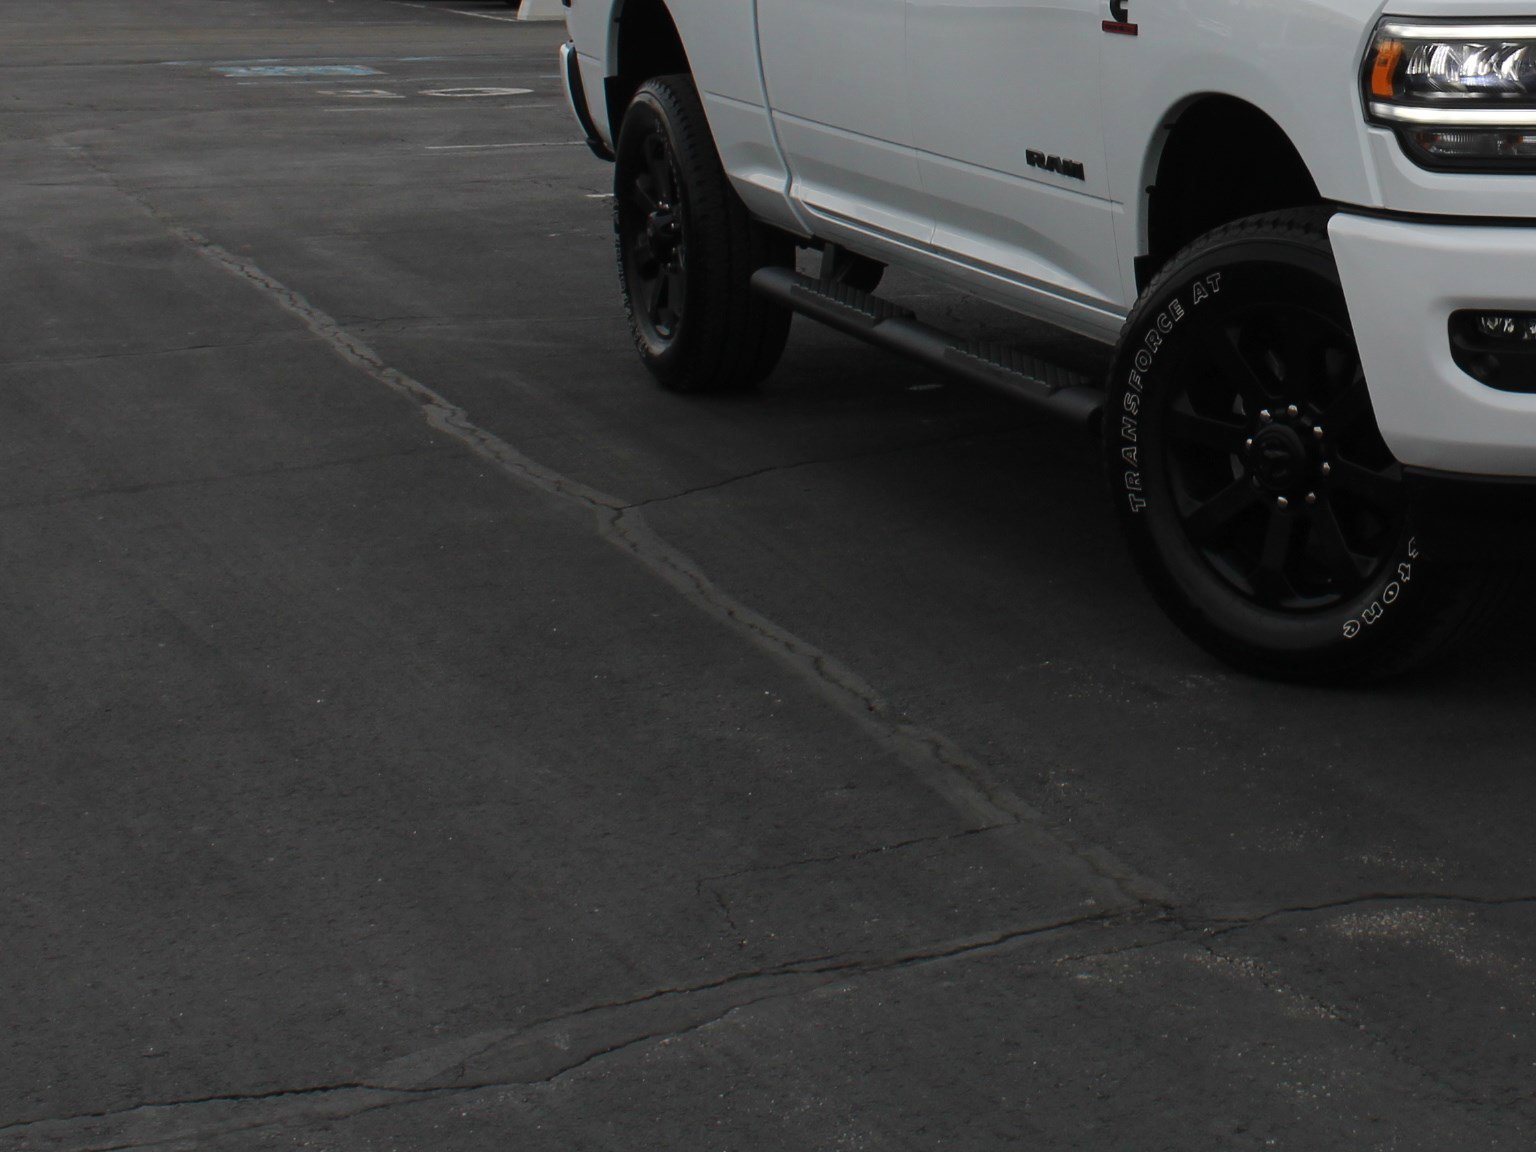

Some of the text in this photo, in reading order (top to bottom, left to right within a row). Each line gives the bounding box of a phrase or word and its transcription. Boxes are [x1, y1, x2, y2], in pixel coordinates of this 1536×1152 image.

[1025, 148, 1086, 182] RAM
[1121, 272, 1222, 512] TRANSFORCE AT
